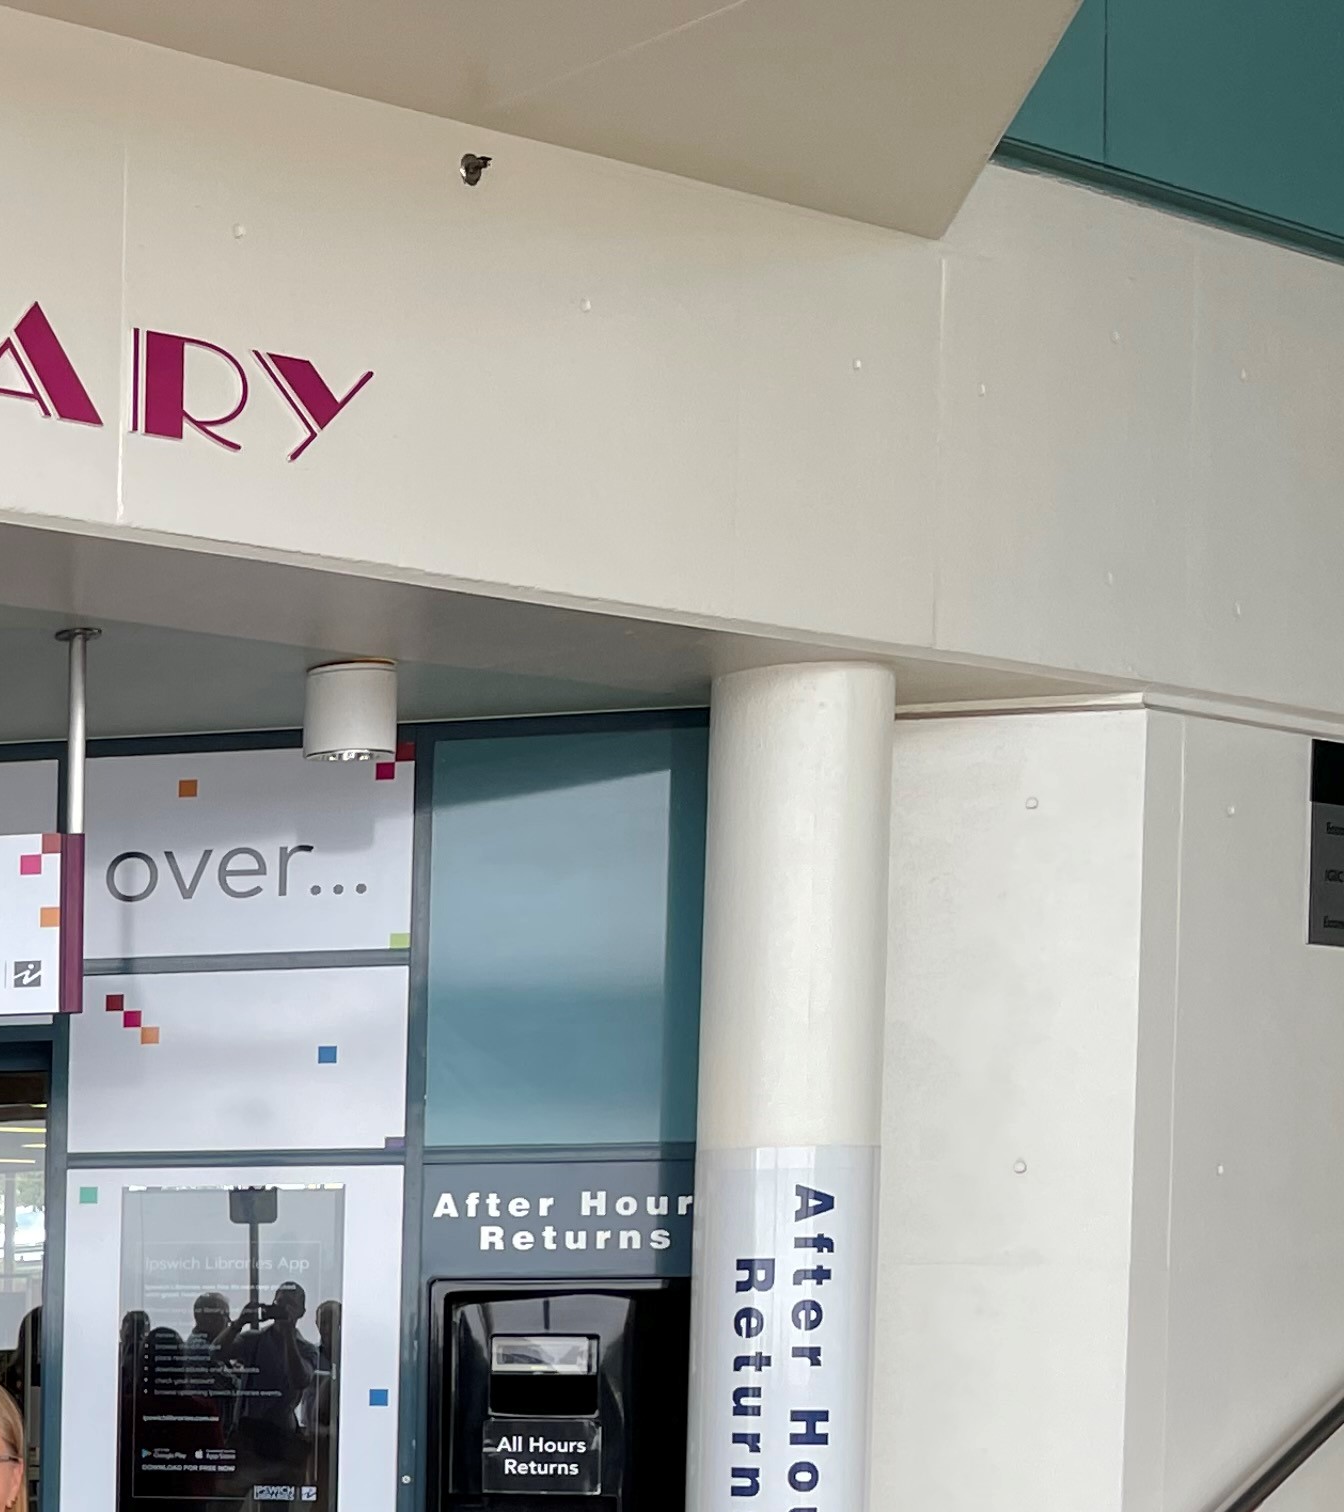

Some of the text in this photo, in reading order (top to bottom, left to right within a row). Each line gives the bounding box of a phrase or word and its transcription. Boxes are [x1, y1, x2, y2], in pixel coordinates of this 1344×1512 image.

[106, 845, 367, 902] over...
[433, 1193, 695, 1219] After Hour
[480, 1224, 672, 1251] Returns
[144, 1255, 200, 1273] Ipswich
[278, 1256, 310, 1273] App
[794, 1184, 835, 1368] After
[495, 1435, 588, 1454] All Hours
[503, 1456, 579, 1478] Returns
